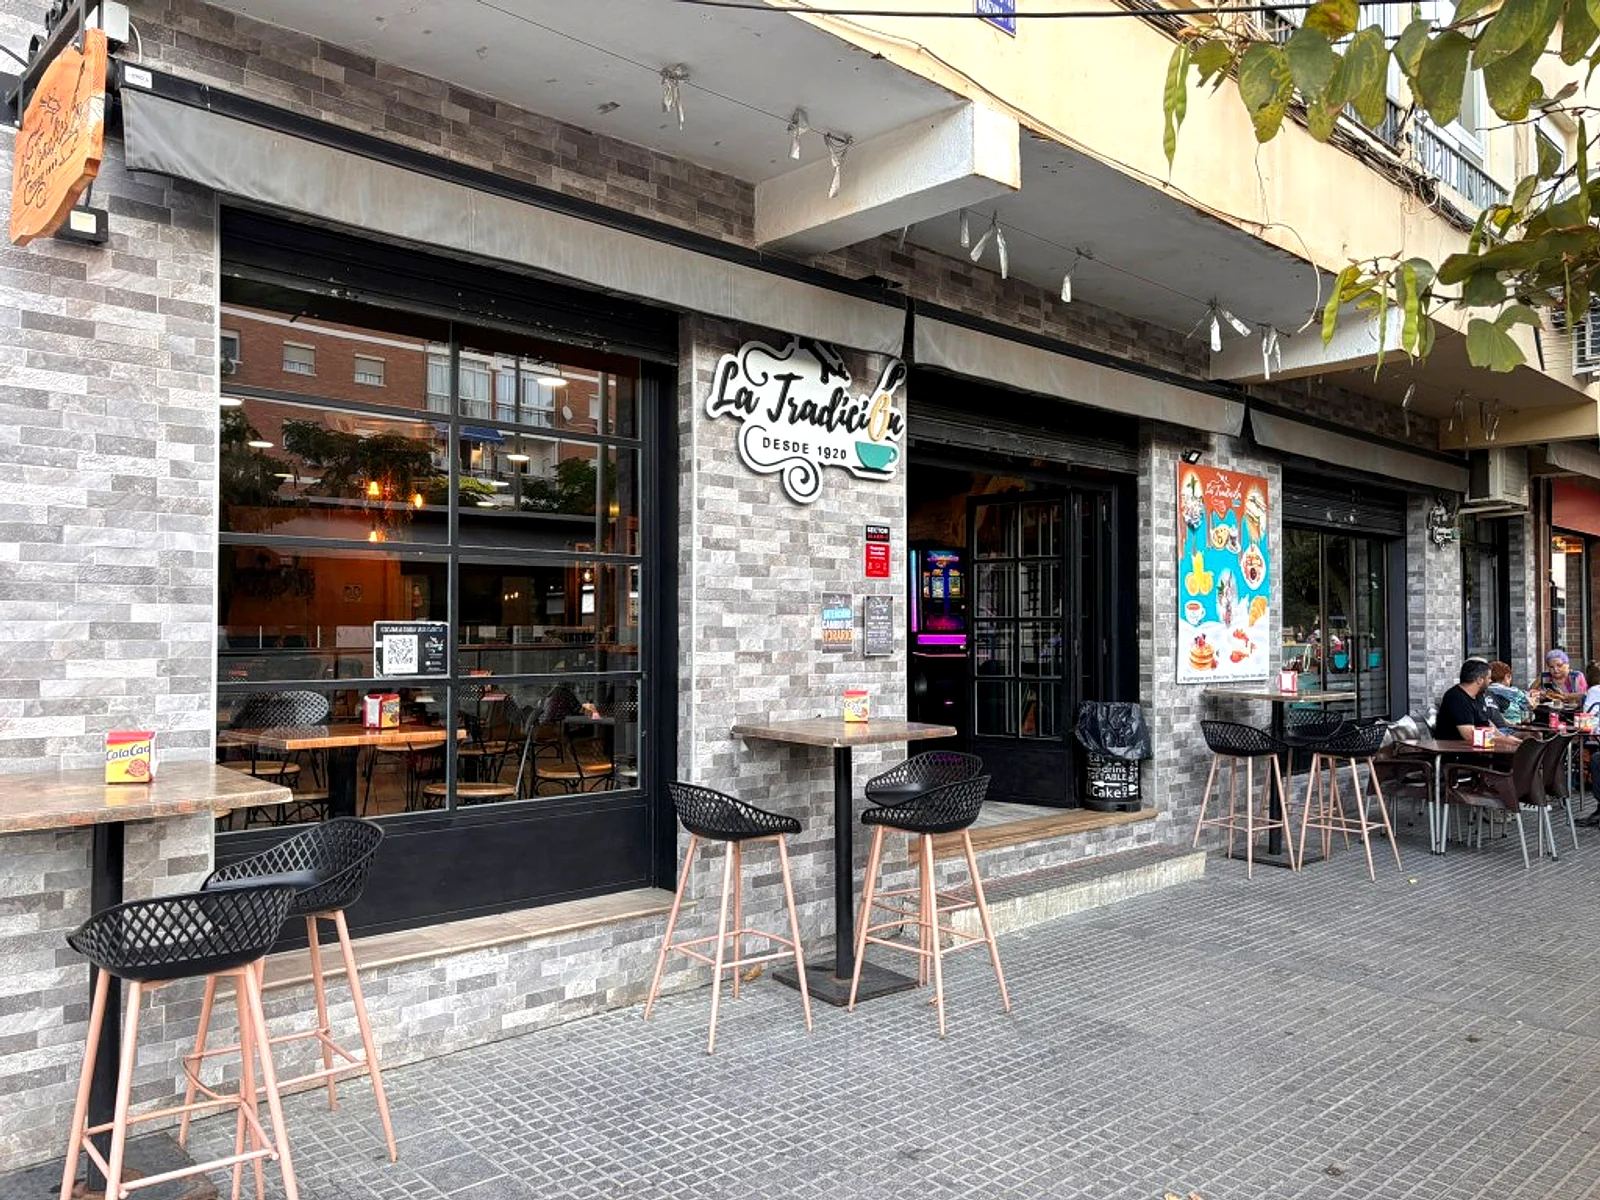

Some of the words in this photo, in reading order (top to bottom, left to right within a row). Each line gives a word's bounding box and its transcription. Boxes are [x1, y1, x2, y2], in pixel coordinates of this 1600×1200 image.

[713, 361, 760, 414] La
[762, 437, 810, 454] DESDE
[817, 445, 847, 460] 1920
[1092, 786, 1121, 798] Cake
